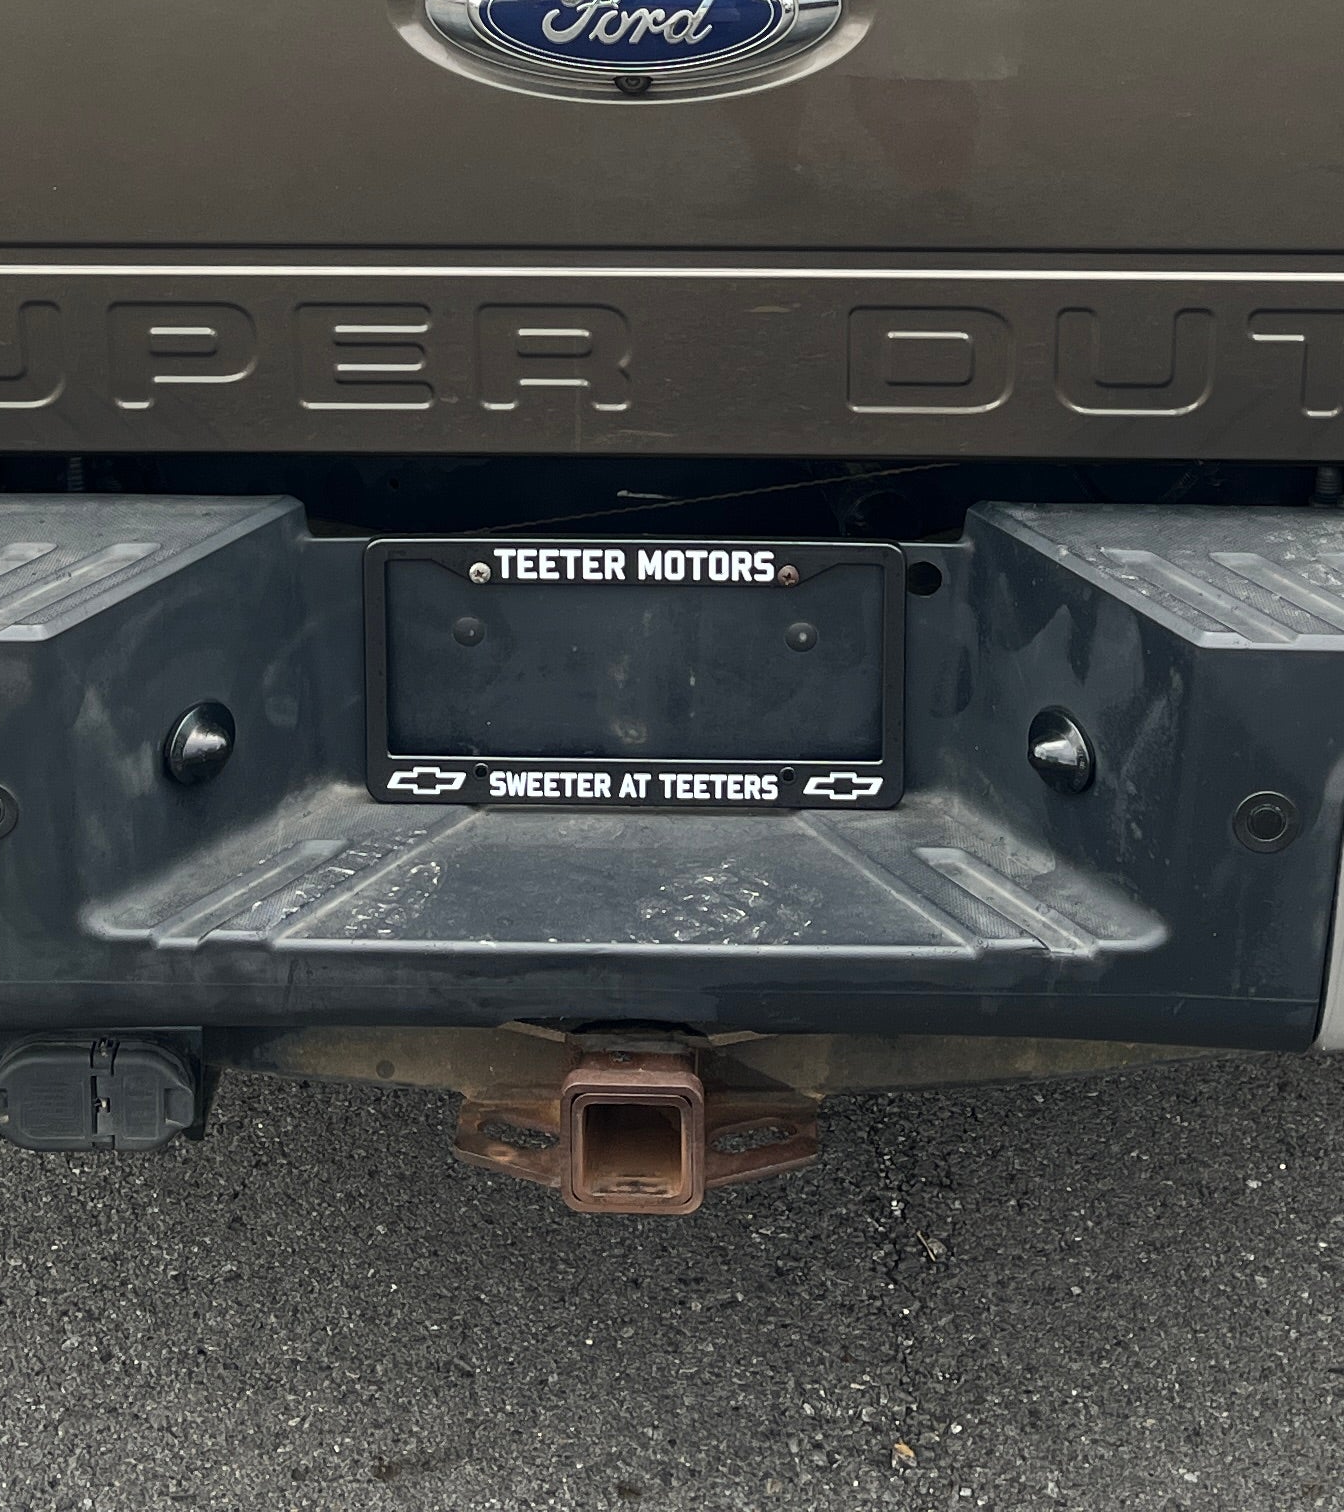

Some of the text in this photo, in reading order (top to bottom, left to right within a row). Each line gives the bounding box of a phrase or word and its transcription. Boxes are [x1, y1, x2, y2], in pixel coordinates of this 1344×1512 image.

[493, 547, 775, 583] TEETER MOTORS
[488, 770, 779, 801] SWEETER AT TEETERS
